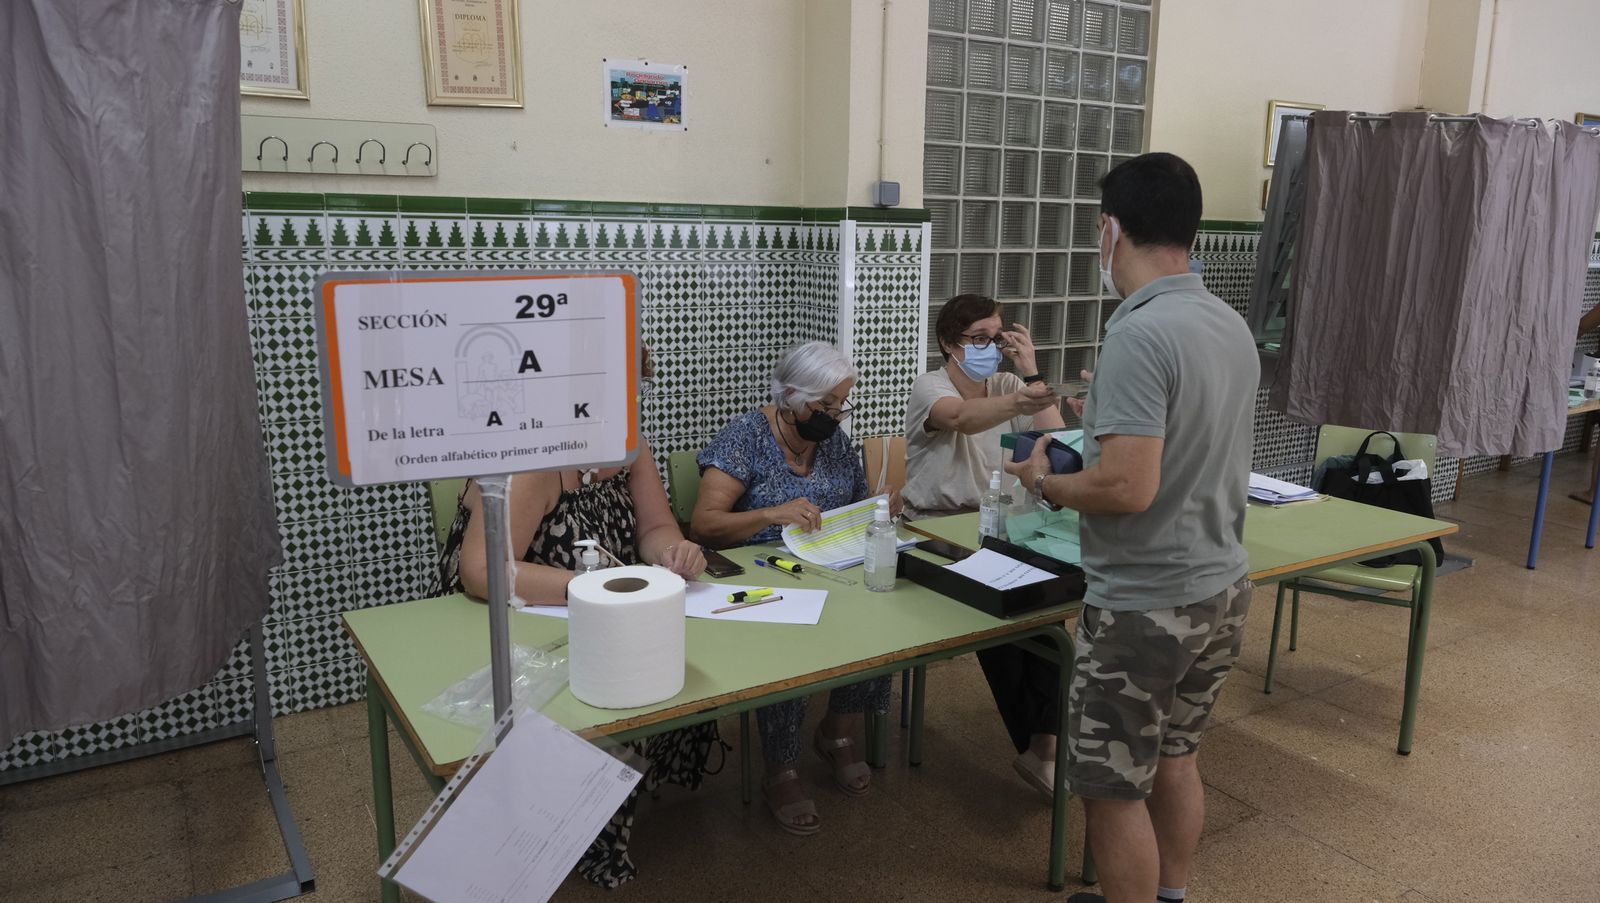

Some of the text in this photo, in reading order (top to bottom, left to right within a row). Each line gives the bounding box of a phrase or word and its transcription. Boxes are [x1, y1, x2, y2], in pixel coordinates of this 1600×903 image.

[454, 13, 487, 21] DIPLOMA
[358, 309, 448, 330] SECCIÓN
[364, 350, 542, 390] MESA A
[368, 403, 590, 441] De la letra A a la K
[395, 440, 588, 467] (Orden alfabético primer apellido)
